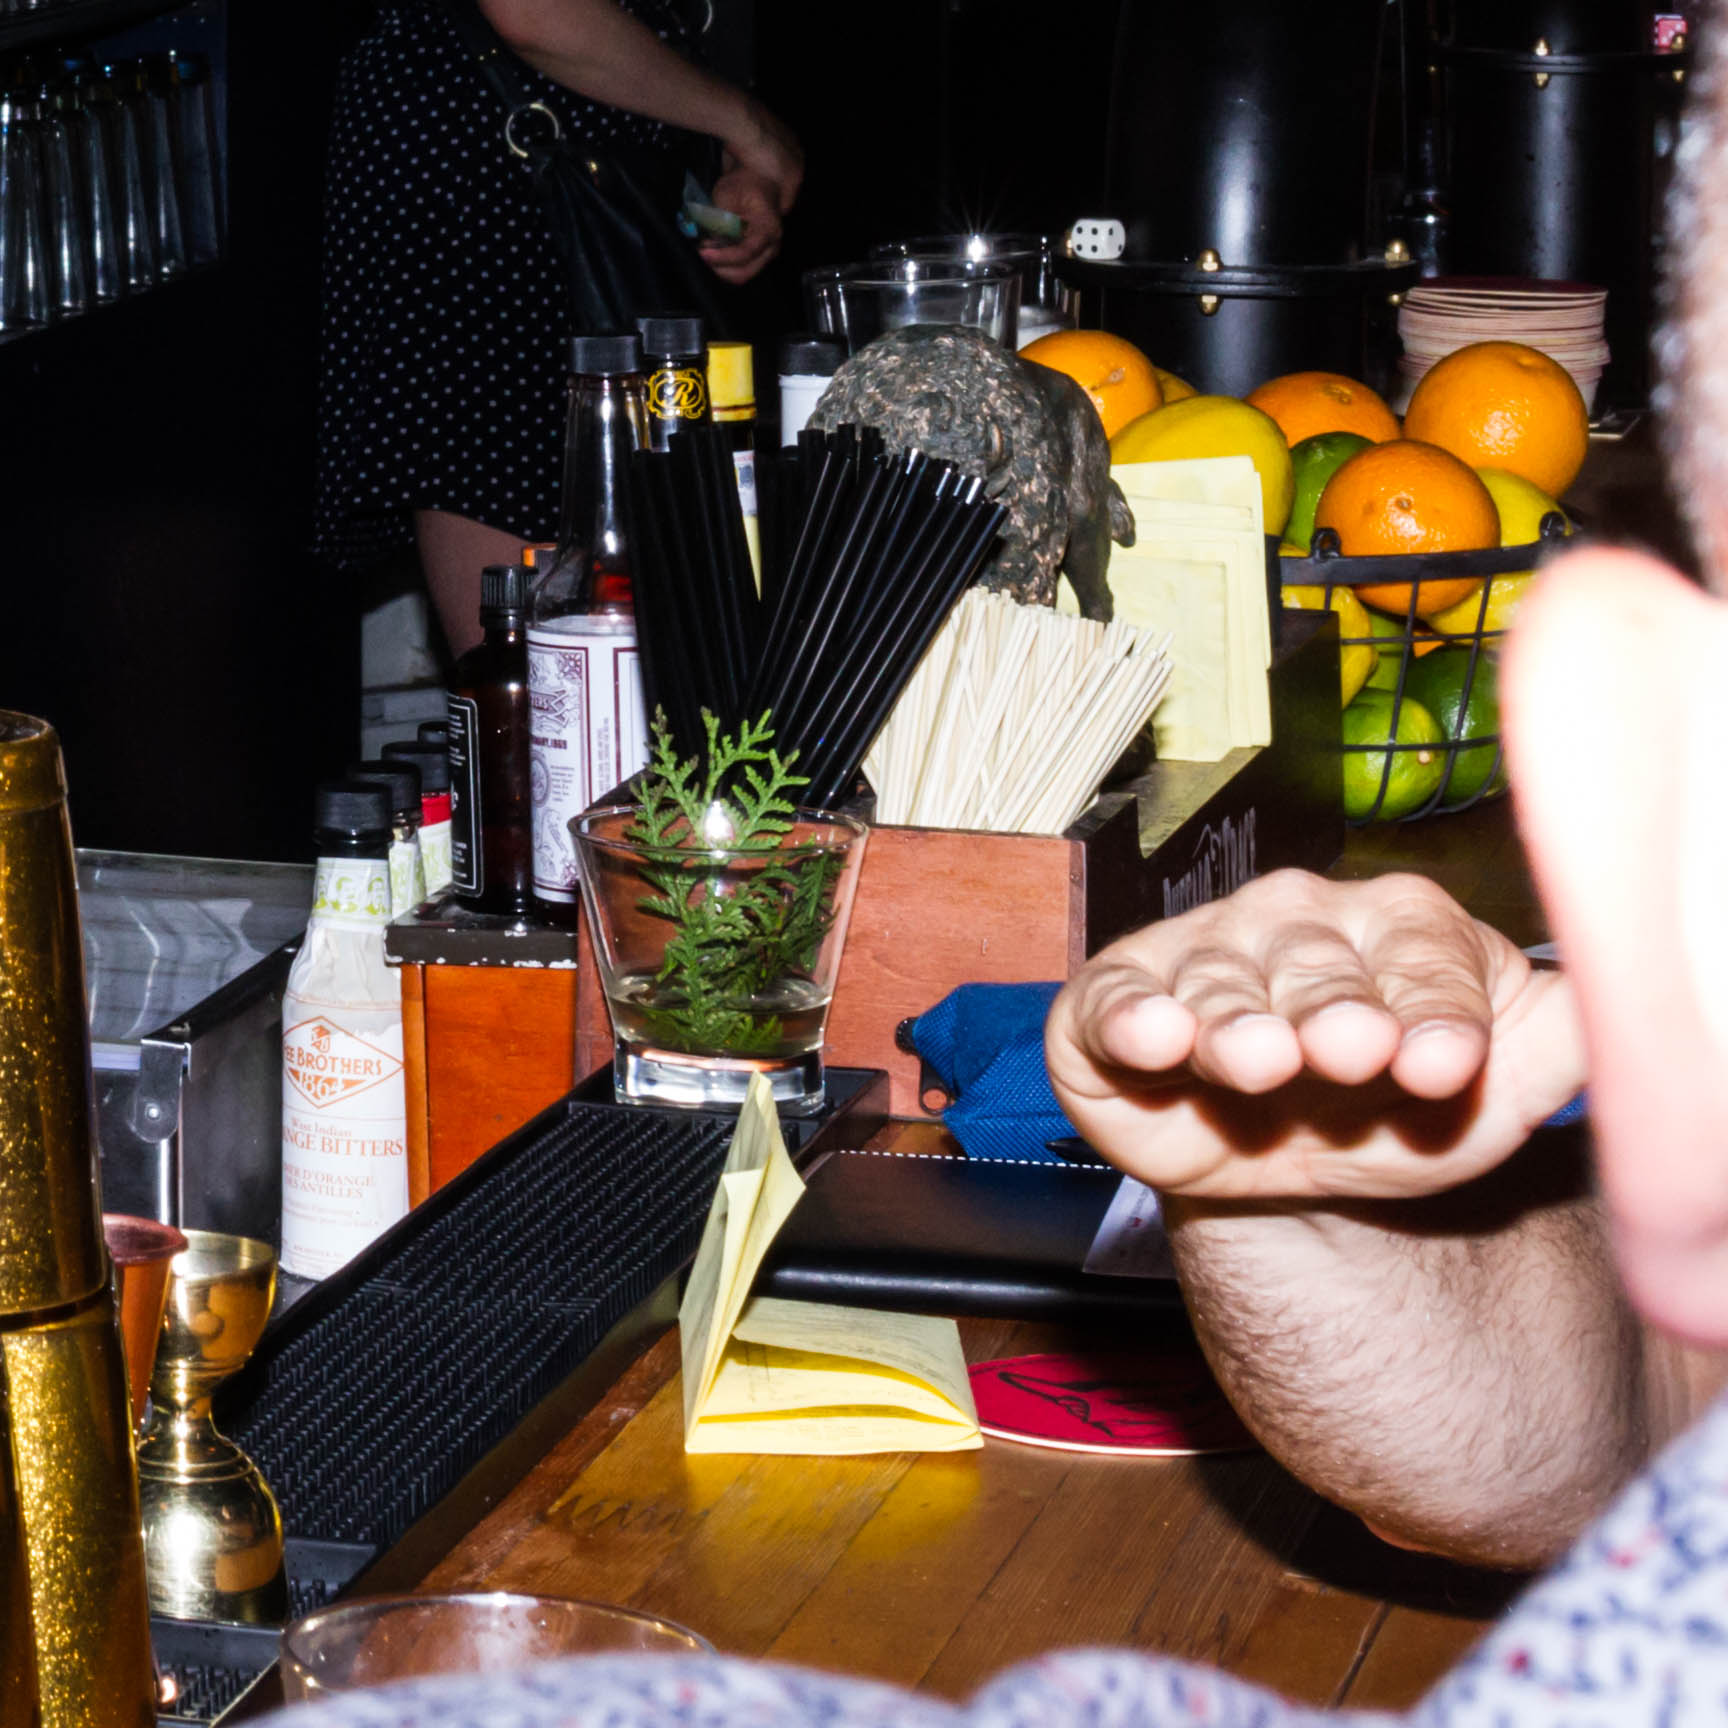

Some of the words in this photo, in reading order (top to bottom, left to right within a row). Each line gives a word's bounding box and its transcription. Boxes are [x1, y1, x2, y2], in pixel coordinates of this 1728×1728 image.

[297, 1046, 383, 1076] BROTHERS
[315, 1121, 352, 1137] Indian
[320, 1135, 404, 1157] BITTERS
